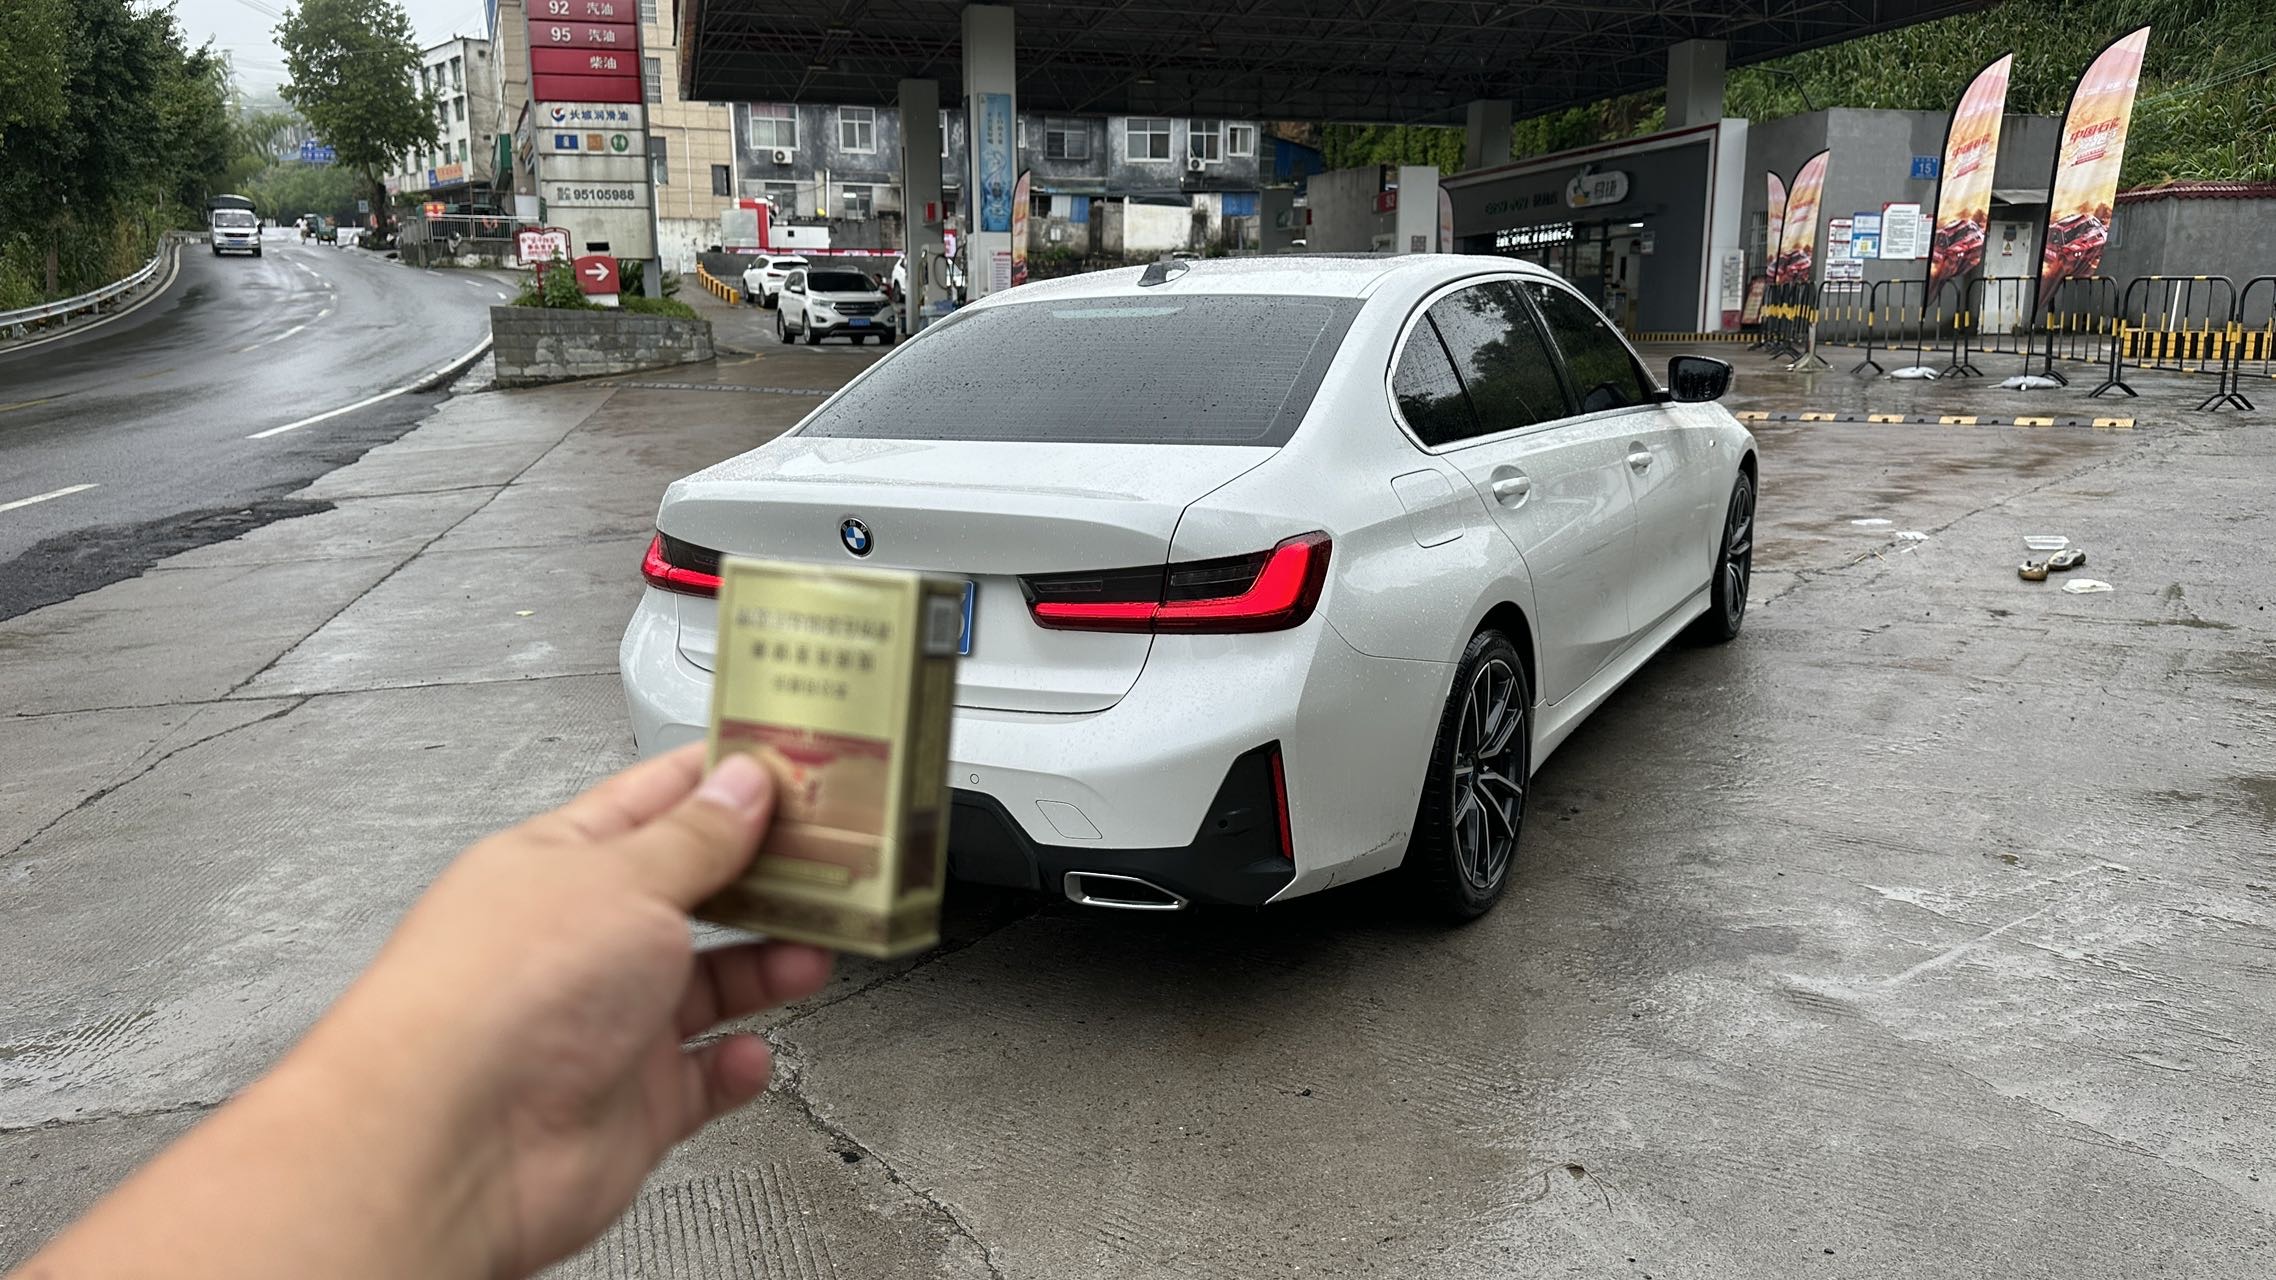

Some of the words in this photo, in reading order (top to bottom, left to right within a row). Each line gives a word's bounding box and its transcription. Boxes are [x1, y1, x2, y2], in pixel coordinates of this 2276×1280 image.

[549, 0, 570, 15] 92
[587, 2, 614, 15] 汽油
[551, 27, 571, 41] 95
[589, 29, 616, 42] 汽油
[590, 56, 617, 69] 柴油
[1920, 163, 1932, 174] 15
[573, 189, 635, 200] 95105988
